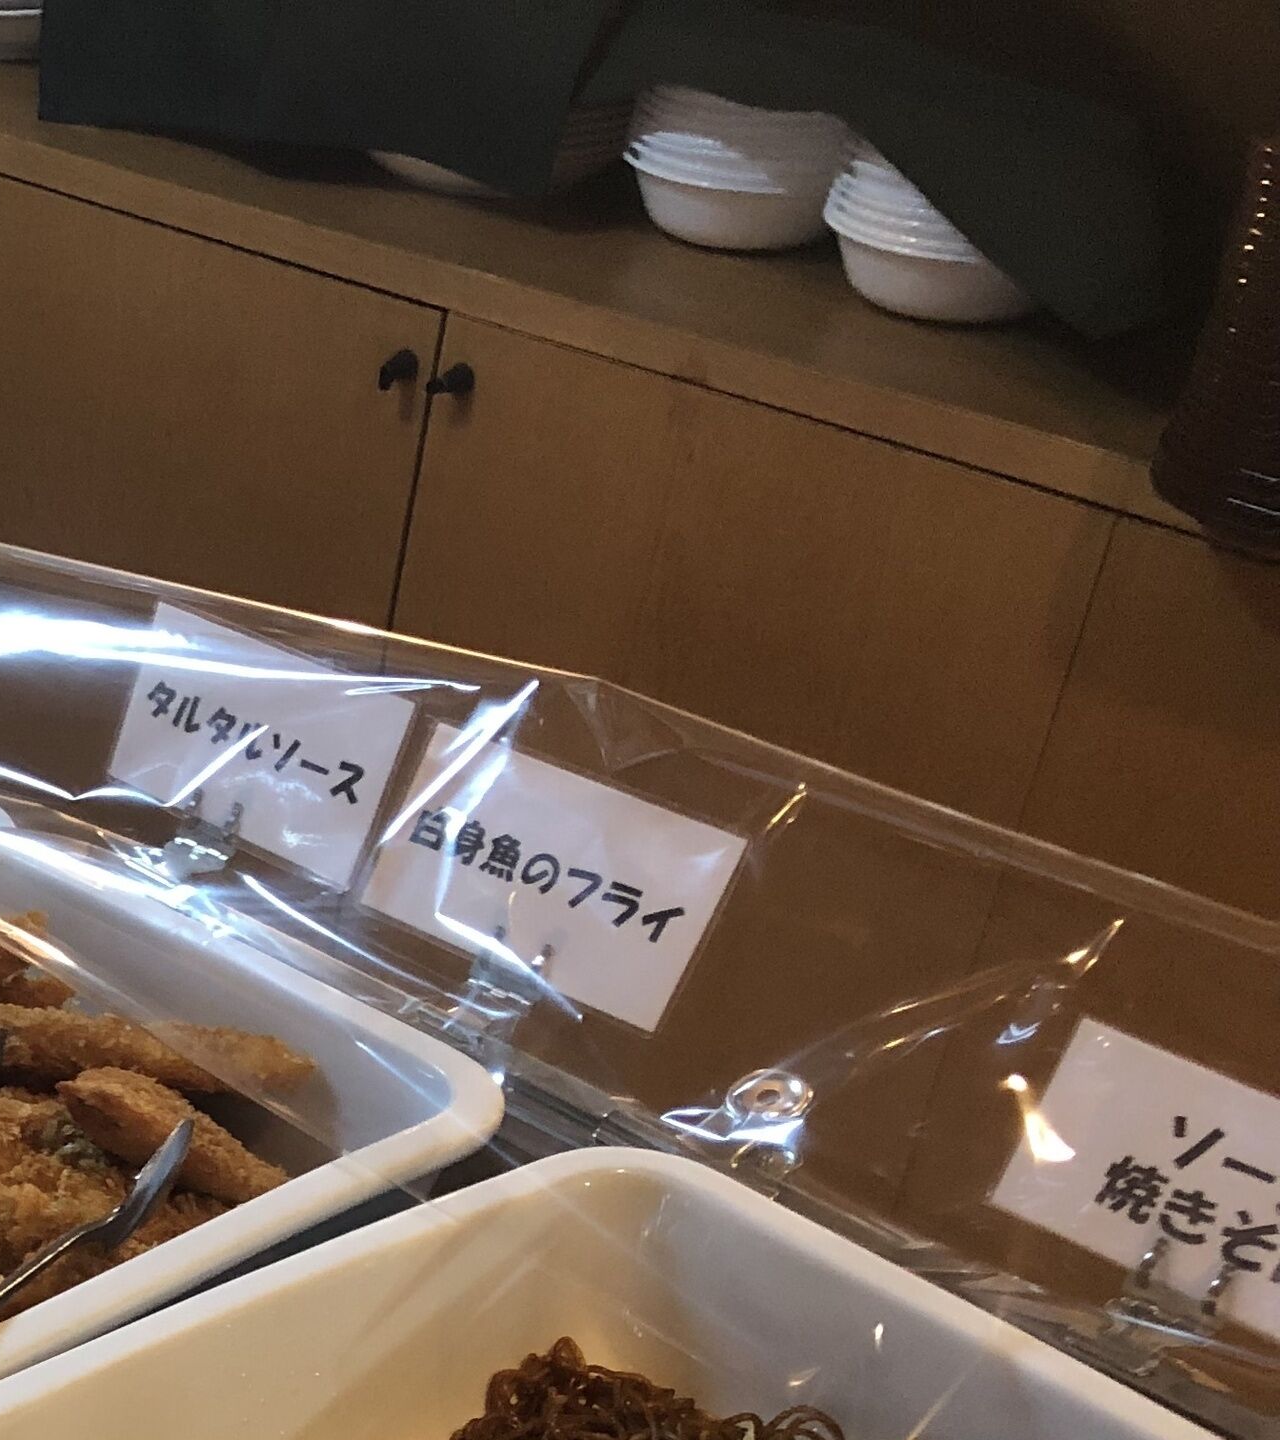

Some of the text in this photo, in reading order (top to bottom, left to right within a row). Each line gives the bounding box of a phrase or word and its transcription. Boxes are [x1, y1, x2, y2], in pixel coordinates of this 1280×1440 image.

[147, 680, 364, 804] タルタルソース
[408, 806, 685, 942] 白身魚のフライ
[1095, 1156, 1280, 1280] 焼きそ
